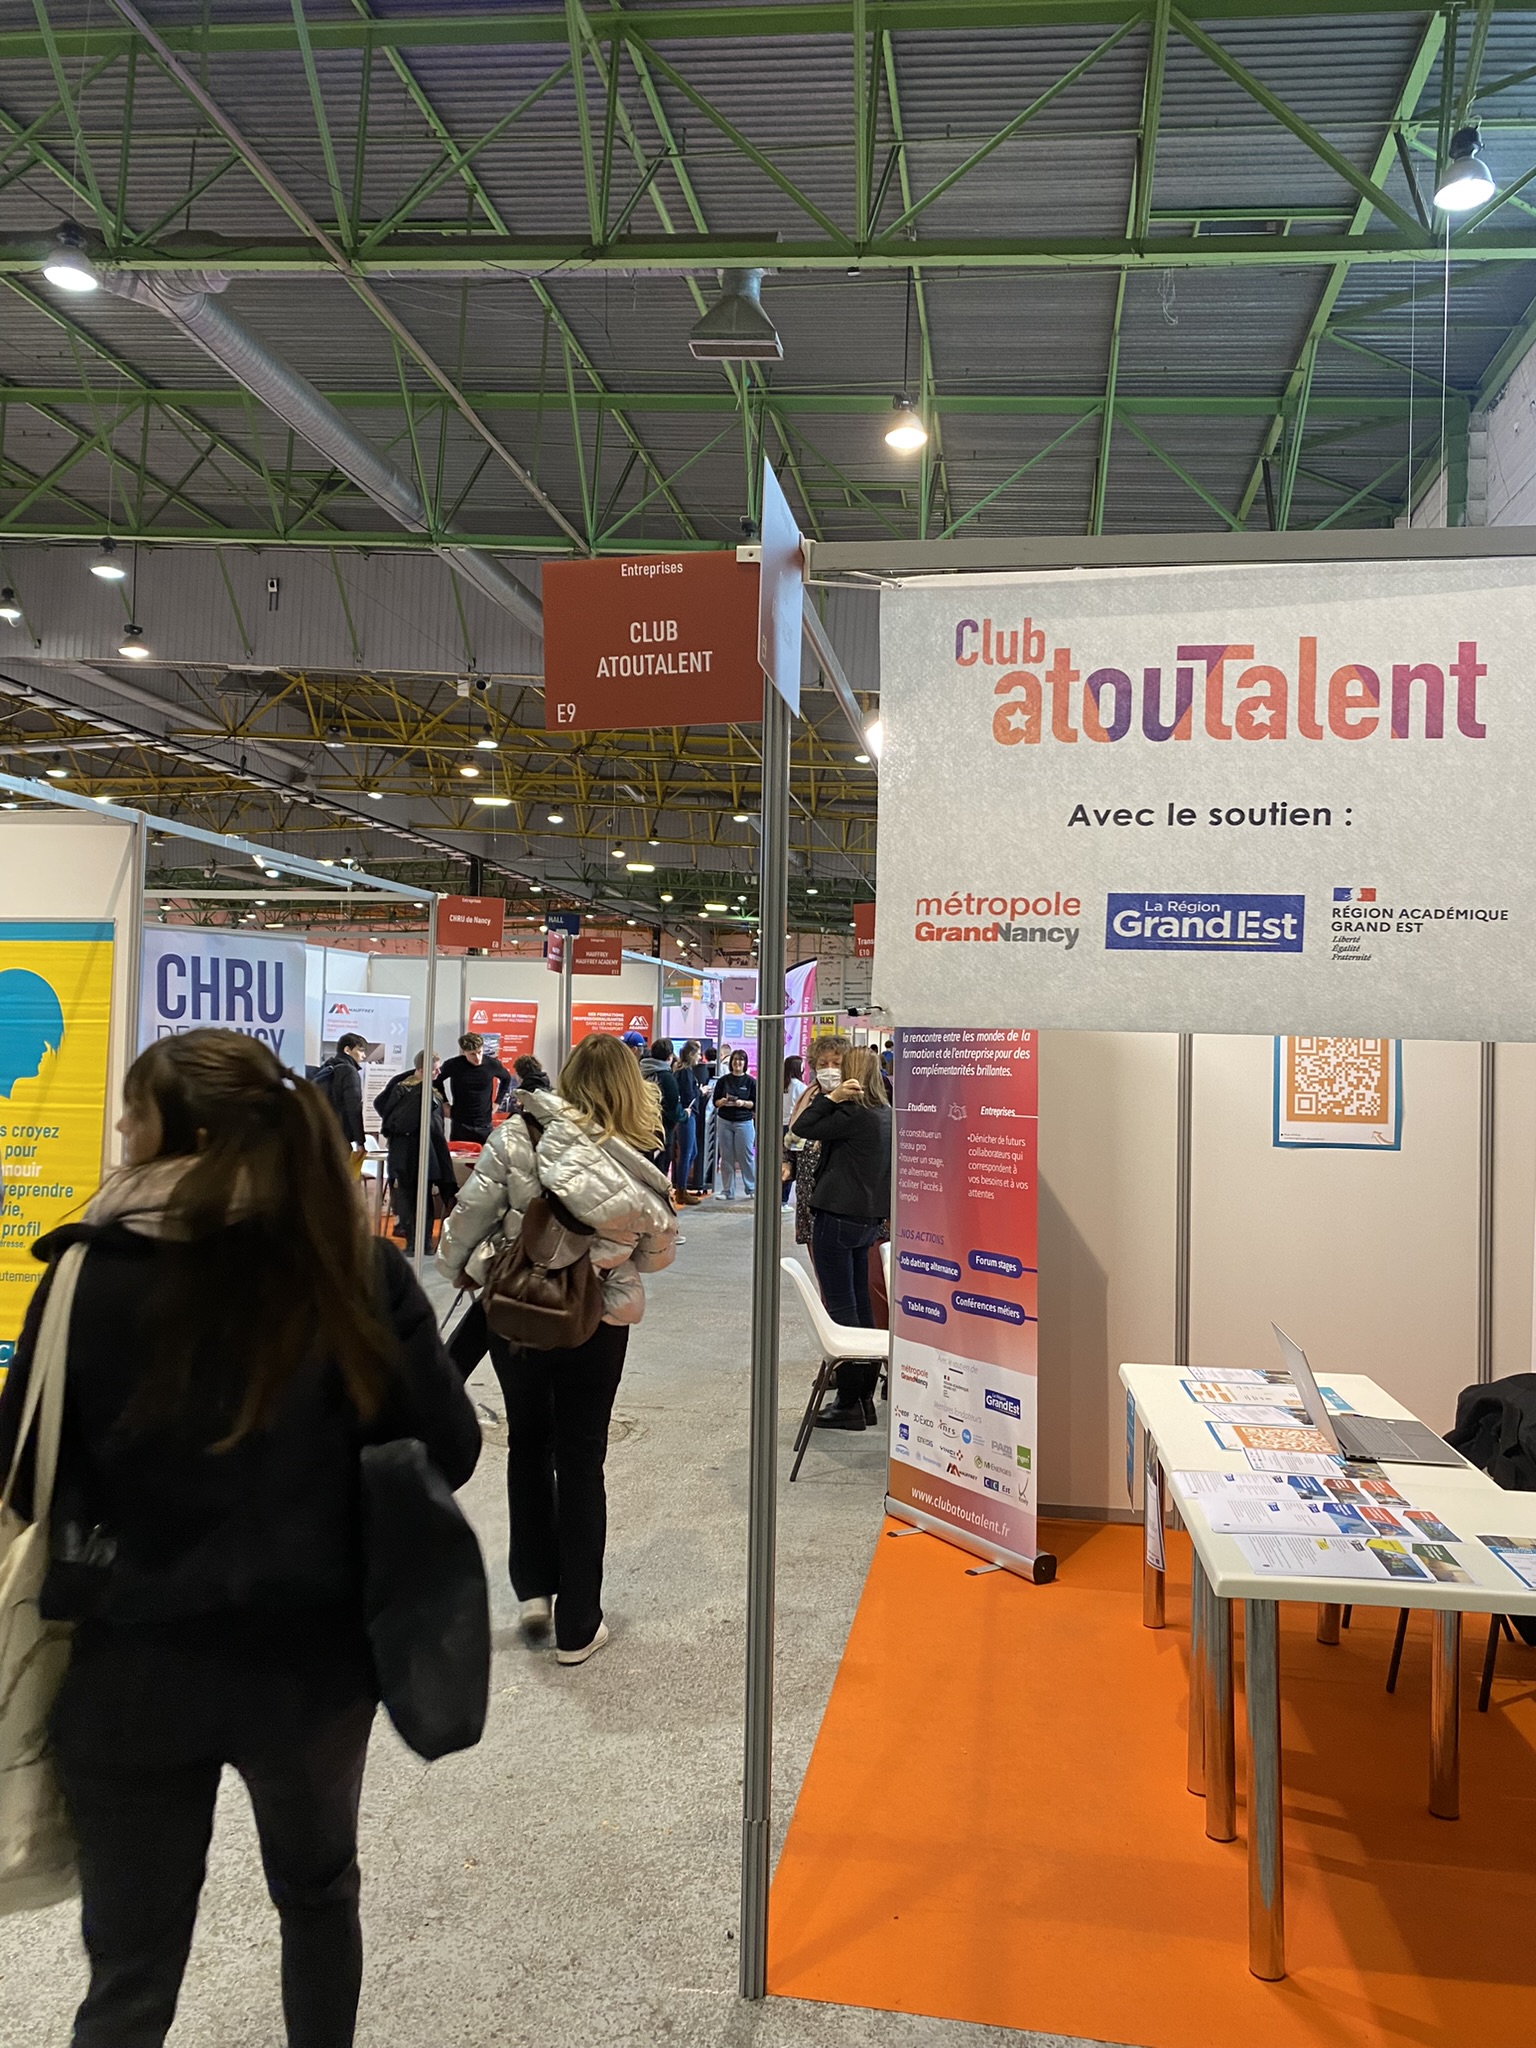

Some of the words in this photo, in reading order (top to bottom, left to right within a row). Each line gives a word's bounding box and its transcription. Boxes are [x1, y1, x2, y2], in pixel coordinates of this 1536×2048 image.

[621, 562, 684, 578] Entreprises
[629, 620, 678, 644] CLUB
[955, 617, 1045, 667] Club
[596, 651, 713, 678] ATOUTALENT
[557, 703, 576, 723] E9
[1067, 803, 1155, 827] Avec
[1167, 802, 1197, 827] le
[1208, 801, 1332, 827] soutien
[915, 891, 1081, 921] métropole
[1144, 900, 1163, 912] La
[1167, 899, 1221, 914] Région
[1332, 905, 1394, 919] RÉGION
[1398, 906, 1509, 922] ACADÉMIQUE
[449, 914, 466, 924] CHRU
[466, 915, 473, 924] de
[473, 915, 491, 927] Nancy
[548, 916, 564, 924] HALL
[1331, 921, 1391, 933] GRAND
[1395, 922, 1424, 933] EST
[1331, 935, 1361, 944] Liberté
[1331, 953, 1372, 962] Fraternité
[156, 953, 284, 1024] CHRU
[909, 1032, 941, 1043] rencontre
[942, 1032, 960, 1042] entre
[962, 1030, 974, 1042] les
[976, 1030, 1005, 1042] mondes
[1006, 1029, 1018, 1042] de
[1021, 1029, 1031, 1042] la
[902, 1048, 935, 1059] formation
[935, 1049, 942, 1059] et
[994, 1050, 1012, 1061] pour
[1013, 1047, 1031, 1059] des
[911, 1062, 975, 1077] complémentarités
[976, 1064, 1012, 1077] brillantes.
[980, 1106, 1016, 1117] Entreprises
[12, 1125, 60, 1141] croyez
[906, 1128, 934, 1139] constituer
[969, 1133, 997, 1144] Dénicher
[997, 1136, 1005, 1145] de
[1005, 1136, 1026, 1146] futurs
[5, 1145, 38, 1160] pour
[915, 1143, 927, 1153] pro
[968, 1147, 1011, 1160] collaborateurs
[1011, 1151, 1024, 1162] qui
[919, 1156, 928, 1164] un
[907, 1166, 939, 1179] alternance
[968, 1161, 1012, 1174] correspondent
[1012, 1164, 1018, 1175] à
[938, 1182, 943, 1193] à
[967, 1175, 980, 1184] vos
[980, 1175, 1003, 1187] besoins
[1003, 1178, 1010, 1188] et
[1010, 1179, 1015, 1189] à
[1015, 1181, 1029, 1190] vos
[967, 1188, 995, 1200] attentes
[2, 1222, 41, 1239] profil
[901, 1228, 915, 1240] NOS
[915, 1230, 945, 1246] ACTIONS
[900, 1256, 910, 1265] Job
[910, 1259, 930, 1272] dating
[930, 1261, 959, 1277] alternance
[975, 1255, 998, 1267] Forum
[997, 1260, 1017, 1273] stages
[908, 1301, 925, 1313] Table
[925, 1307, 941, 1318] ronde
[955, 1295, 997, 1313] Conférences
[997, 1304, 1020, 1319] métiers
[900, 1364, 929, 1379] métropole
[911, 1487, 1011, 1537] www.clubatoutalent.fr
